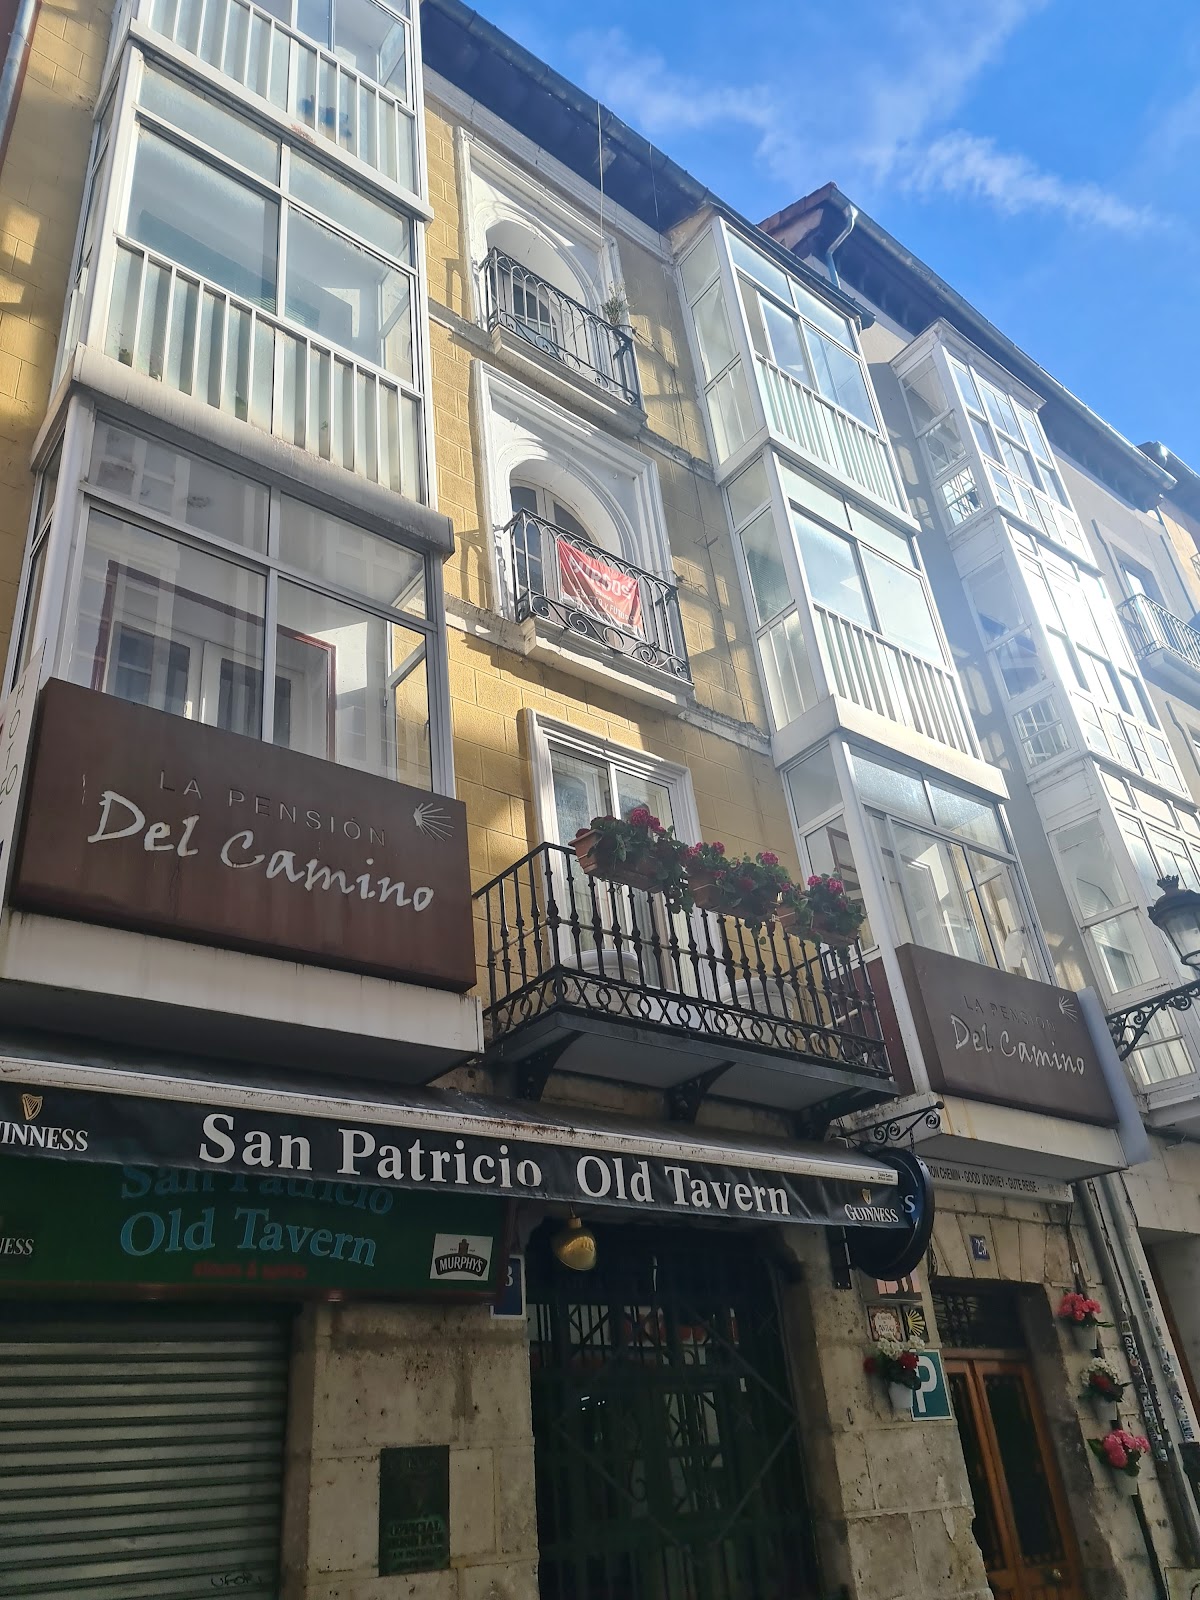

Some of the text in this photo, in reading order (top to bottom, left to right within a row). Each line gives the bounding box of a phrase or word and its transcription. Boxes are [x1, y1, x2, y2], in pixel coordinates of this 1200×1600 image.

[159, 770, 386, 846] LA PENSIÓN
[87, 790, 434, 912] Del Camino
[963, 995, 984, 1014] LA
[950, 1013, 1085, 1076] Del Camino
[0, 1121, 89, 1151] INNESS
[199, 1113, 791, 1216] San Patricio Old Tavern
[963, 1170, 981, 1185] GOOD
[982, 1173, 1005, 1188] JOURNEY
[120, 1206, 377, 1267] Old Tavern
[844, 1203, 899, 1223] GUINNESS
[915, 1355, 937, 1412] P
